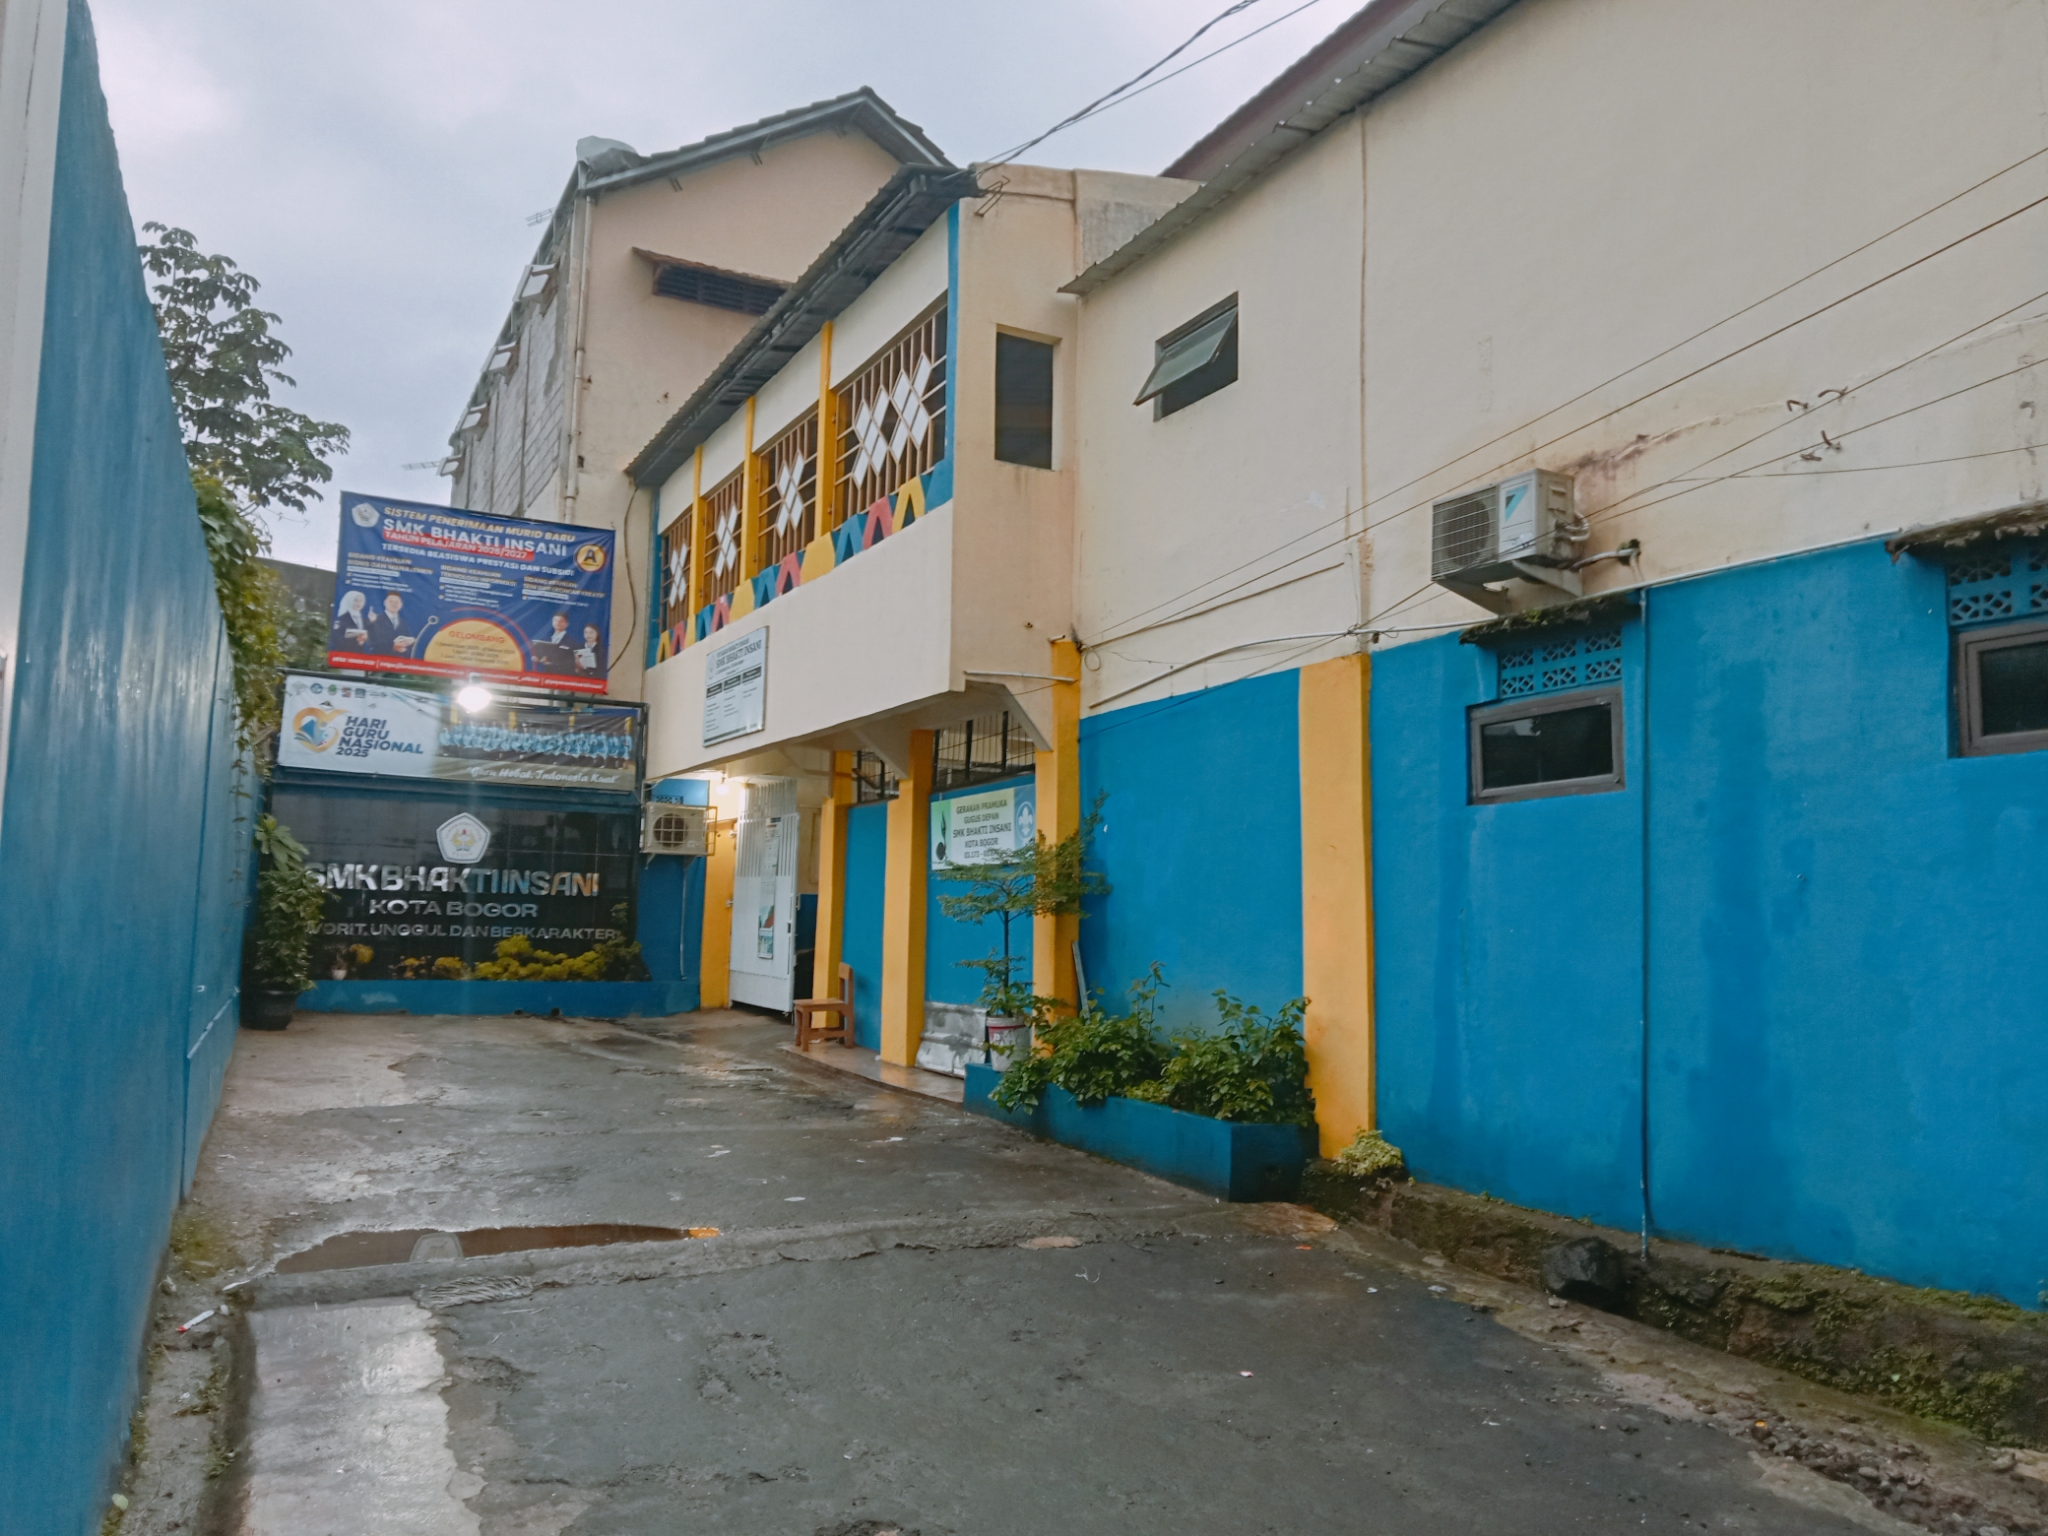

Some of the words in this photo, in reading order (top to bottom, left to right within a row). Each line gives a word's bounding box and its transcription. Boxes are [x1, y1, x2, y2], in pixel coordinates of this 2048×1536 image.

[385, 507, 426, 521] SISTEM
[428, 514, 504, 533] PENERIMAAN
[505, 526, 543, 539] MURID
[545, 531, 576, 542] BARU
[383, 519, 425, 535] SMK
[431, 526, 499, 547] BHAKTI
[505, 538, 567, 556] INSANI
[384, 531, 418, 542] TAHUN
[420, 536, 476, 552] PELAJARAN
[382, 543, 426, 556] TERSEDIA
[427, 550, 475, 563] BEASISWA
[477, 557, 519, 570] PRESTASI
[520, 564, 540, 572] DAN
[448, 631, 506, 644] GELOMBANG
[345, 716, 387, 729] HARI
[343, 727, 390, 740] GURU
[335, 747, 369, 758] 2025
[338, 736, 424, 754] NASIONAL
[535, 769, 589, 783] Indonesia
[956, 803, 980, 814] GERAKAN
[981, 799, 1007, 810] PRAMUKA
[982, 812, 999, 822] DEPAN
[953, 828, 965, 838] SMK
[966, 825, 988, 837] BHAKTI
[989, 822, 1012, 834] INSANI
[965, 839, 979, 848] KOTA
[980, 837, 999, 847] BOGOR
[305, 862, 379, 890] SMK
[381, 865, 499, 894] BHAKTI
[501, 869, 600, 897] INSANI
[369, 899, 442, 916] KOTA
[446, 901, 539, 918] BOGOR
[370, 923, 447, 937] UNGGUL
[448, 925, 489, 938] DAN
[490, 926, 616, 940] BERKARAKTER
